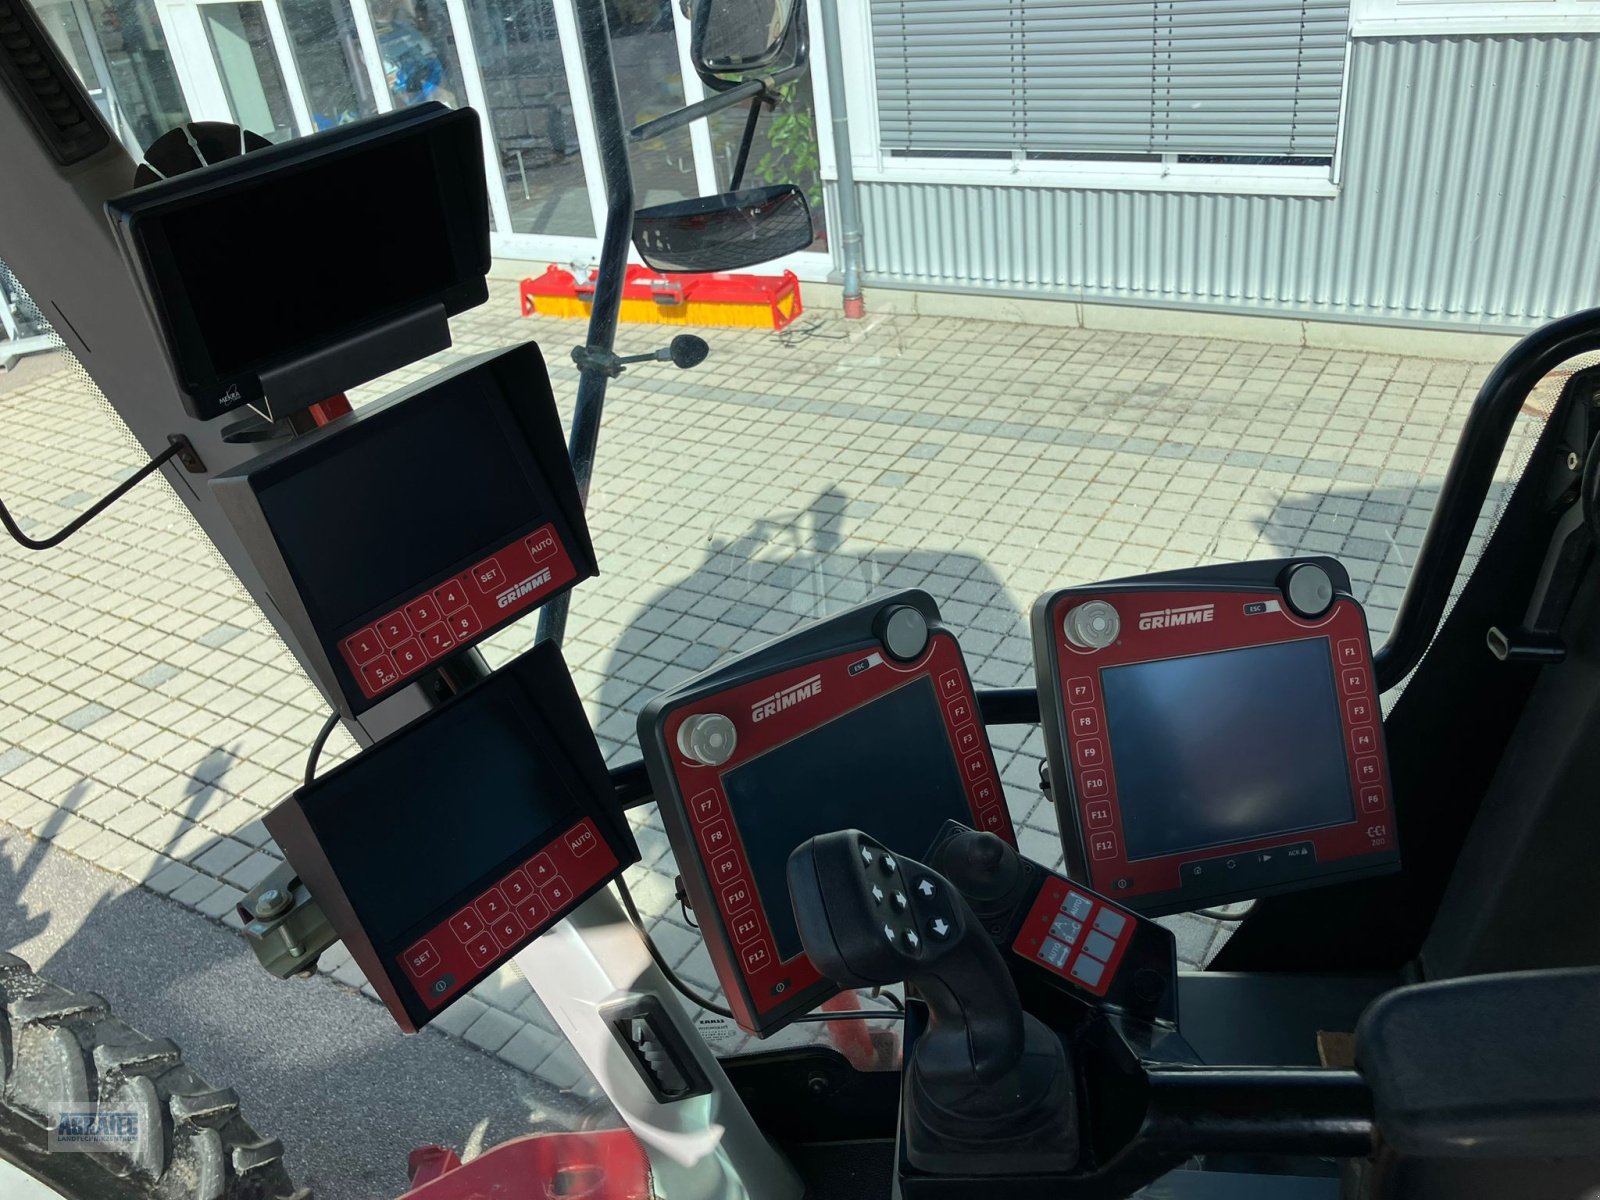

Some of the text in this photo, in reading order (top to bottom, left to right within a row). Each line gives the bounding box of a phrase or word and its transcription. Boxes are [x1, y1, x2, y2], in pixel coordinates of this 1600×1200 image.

[531, 537, 553, 555] AUTO
[480, 568, 497, 583] SET
[496, 567, 552, 609] GRIMME
[447, 593, 455, 602] 4
[418, 609, 427, 618] 3
[1249, 605, 1261, 613] ESC
[1138, 604, 1215, 631] GRIMME
[461, 619, 469, 628] 8
[390, 626, 399, 635] 2
[432, 635, 440, 645] 7
[361, 643, 370, 653] 1
[1344, 647, 1356, 656] F1
[405, 651, 413, 661] 6
[854, 662, 865, 672] ESC
[376, 668, 384, 678] 5
[381, 672, 396, 685] ACK
[1349, 676, 1360, 686] F2
[946, 679, 957, 690] F1
[1075, 686, 1086, 696] F7
[751, 674, 822, 723] GRIMME
[954, 706, 965, 717] F2
[1354, 706, 1365, 715] F3
[1079, 717, 1092, 727] F8
[963, 733, 973, 744] F3
[1358, 735, 1369, 745] F4
[1084, 747, 1096, 758] F9
[971, 761, 981, 771] F4
[1363, 765, 1374, 774] F5
[1086, 778, 1103, 789] F10
[980, 788, 989, 798] F5
[1368, 794, 1379, 804] F6
[700, 800, 712, 812] F7
[1091, 809, 1108, 820] F11
[988, 815, 997, 825] F6
[711, 831, 722, 842] F8
[1366, 825, 1386, 838] CCI
[571, 831, 591, 850] AUTO
[1096, 840, 1112, 851] F12
[538, 865, 545, 874] 4
[721, 861, 733, 873] F9
[513, 883, 521, 892] 3
[553, 889, 561, 897] 8
[728, 890, 745, 904] F10
[488, 902, 497, 911] 2
[529, 907, 537, 916] 7
[1071, 900, 1082, 917] AUTO
[463, 921, 471, 930] 1
[505, 925, 512, 935] 6
[738, 920, 755, 935] F11
[1065, 935, 1074, 943] B
[479, 945, 487, 954] 5
[1048, 942, 1060, 962] AUTO
[413, 950, 430, 967] SET
[748, 950, 766, 964] F12
